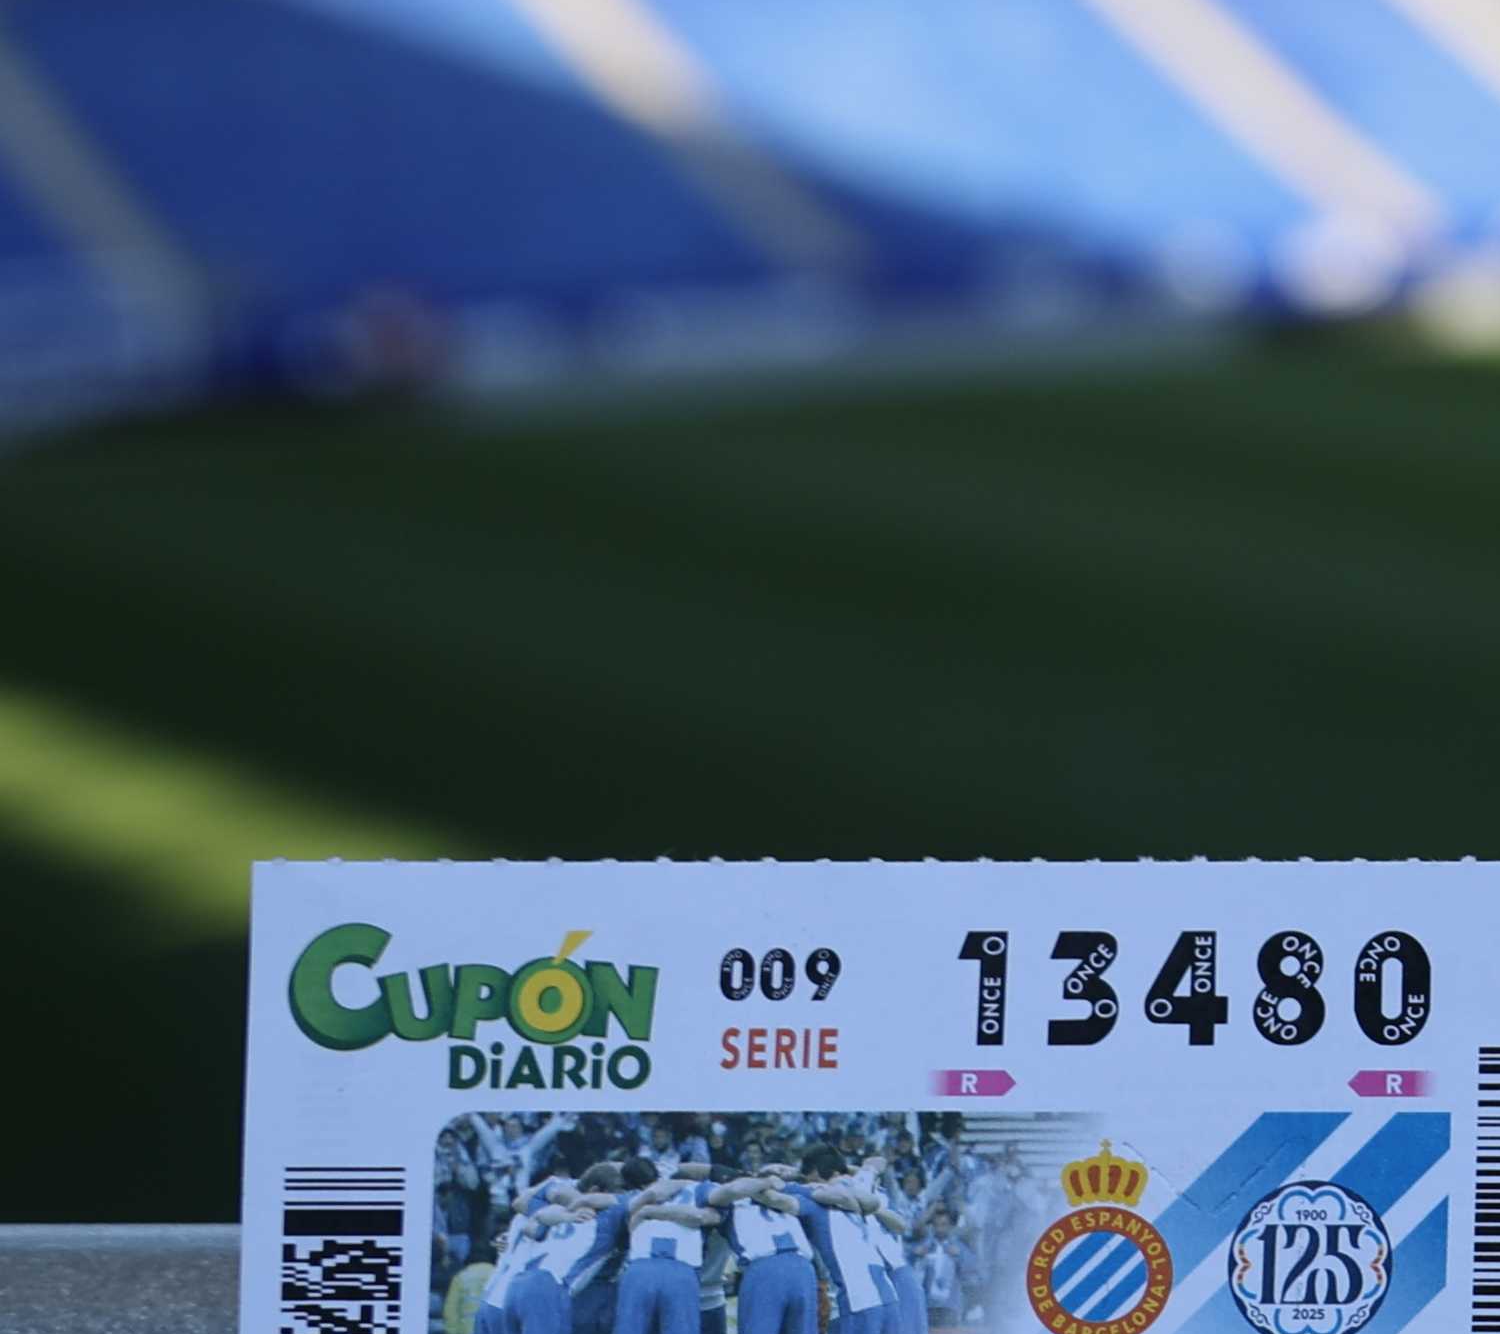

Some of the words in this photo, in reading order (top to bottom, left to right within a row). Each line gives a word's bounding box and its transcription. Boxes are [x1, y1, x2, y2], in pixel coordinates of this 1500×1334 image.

[719, 948, 841, 1001] 009
[957, 930, 1431, 1046] 13480
[720, 1027, 839, 1069] SERIE
[1295, 1209, 1328, 1222] 1900
[1257, 1223, 1366, 1305] 125
[1292, 1307, 1325, 1321] 2025
